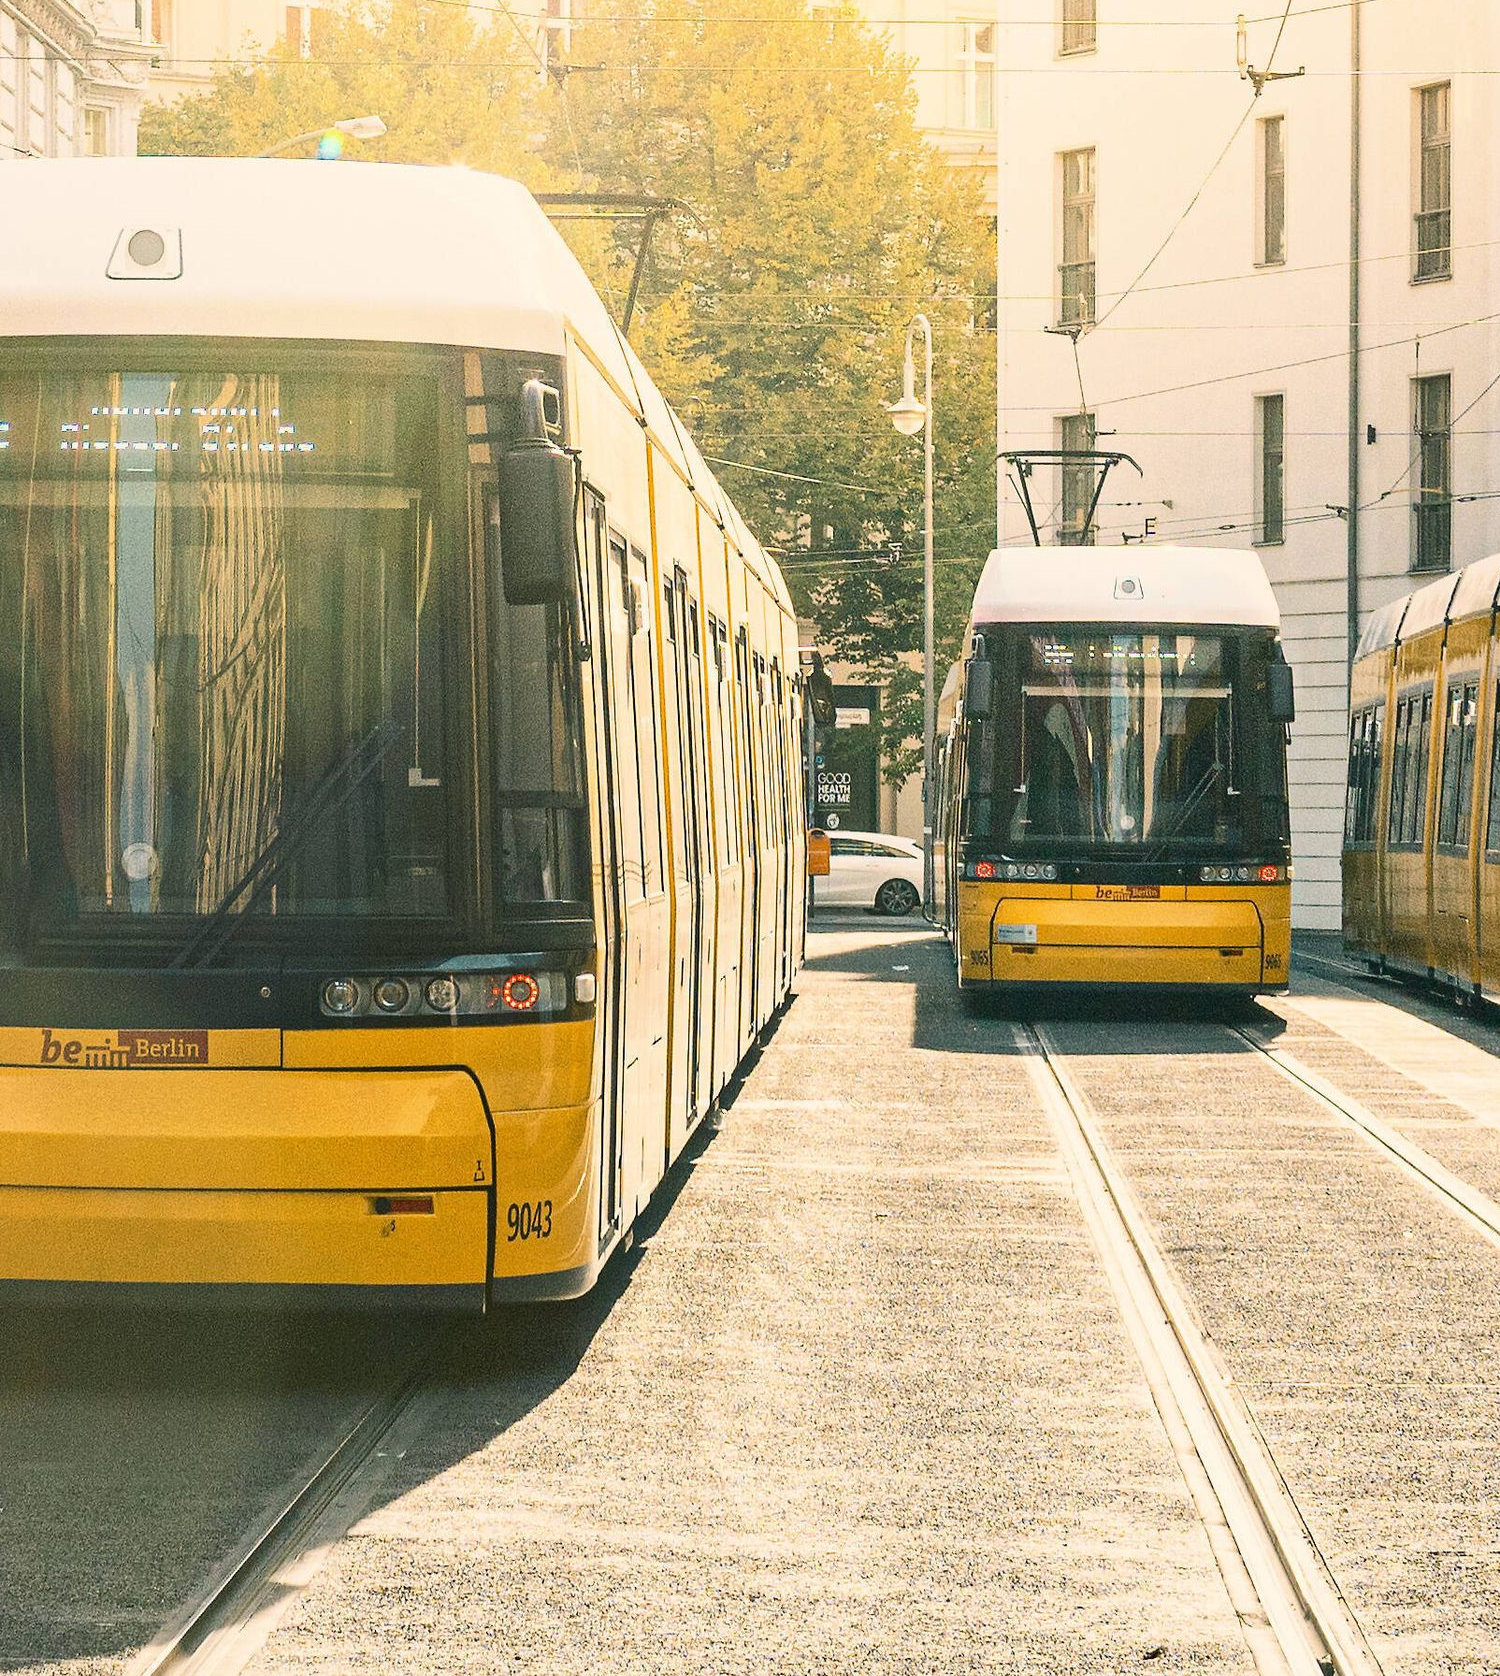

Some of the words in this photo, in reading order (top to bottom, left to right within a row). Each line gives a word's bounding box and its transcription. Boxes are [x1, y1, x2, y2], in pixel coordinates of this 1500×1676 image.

[817, 772, 851, 784] GOOD
[818, 784, 851, 794] HEALTH
[818, 793, 836, 803] FOR
[837, 793, 851, 803] ME
[1095, 885, 1112, 899] be
[40, 1028, 82, 1064] be
[135, 1038, 200, 1058] Berlin
[507, 1200, 552, 1242] 9043
